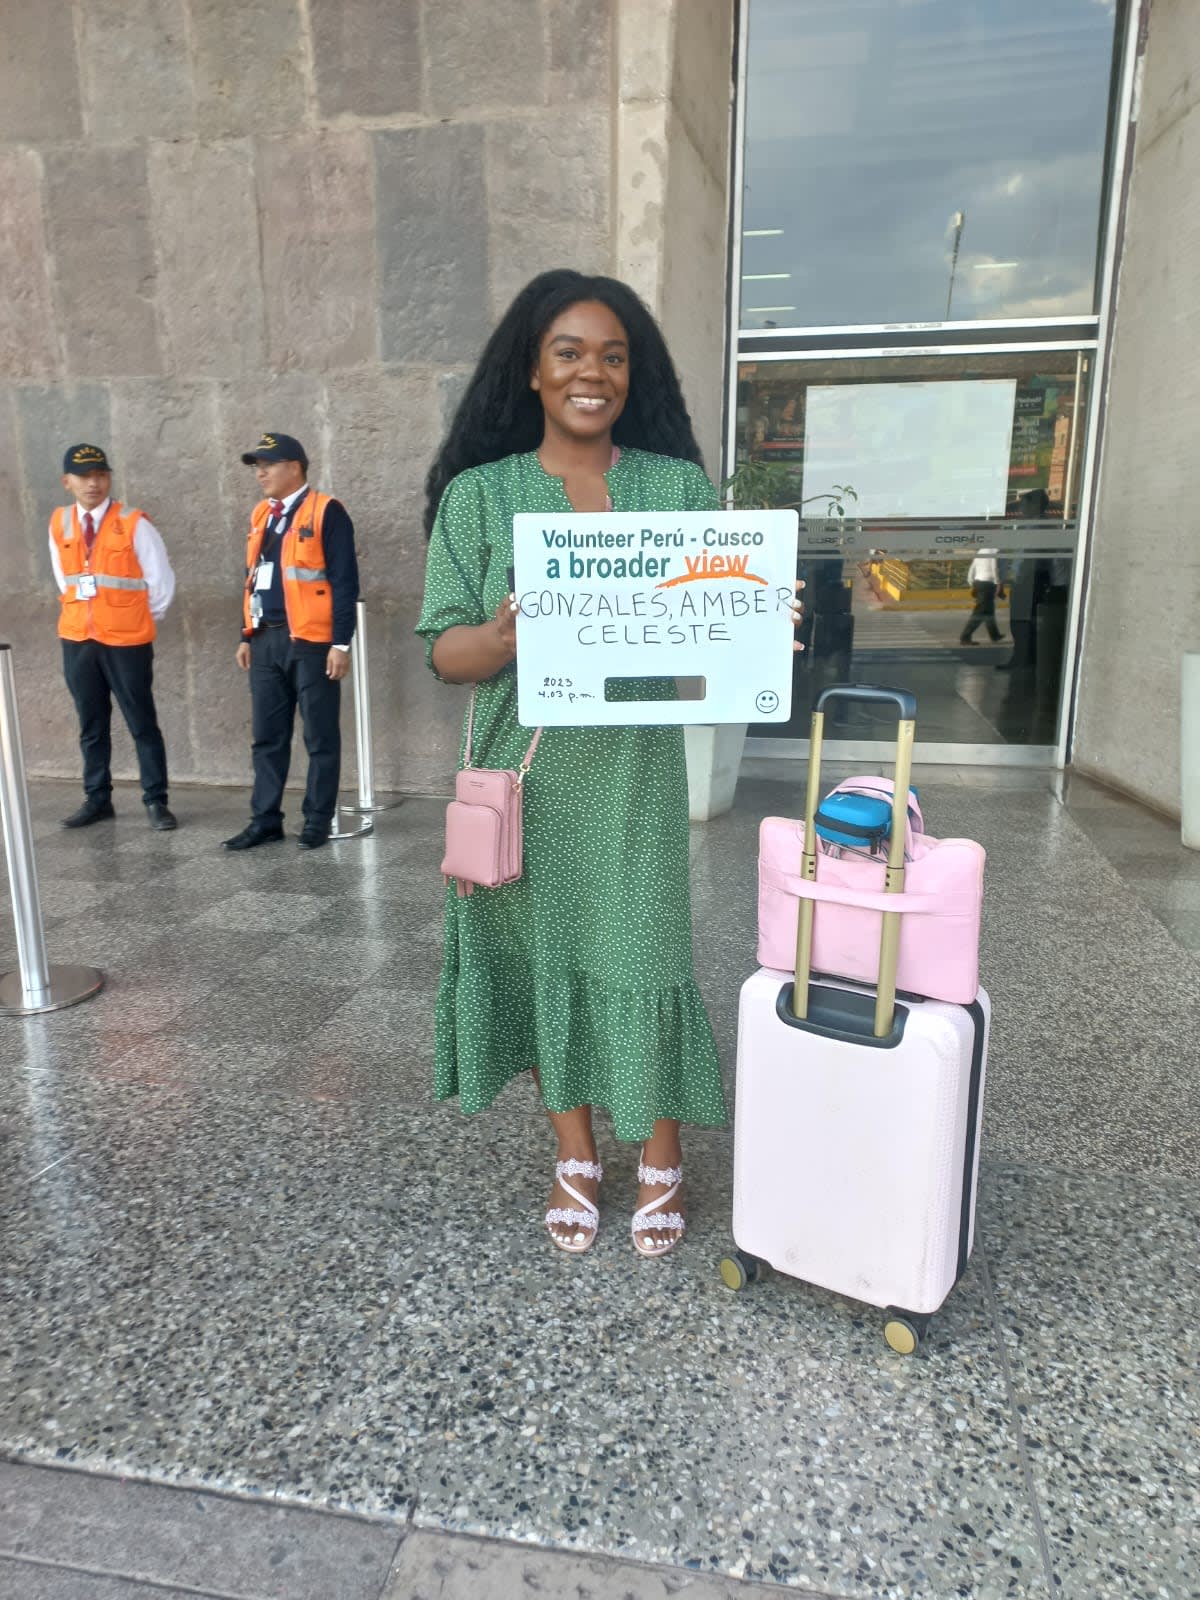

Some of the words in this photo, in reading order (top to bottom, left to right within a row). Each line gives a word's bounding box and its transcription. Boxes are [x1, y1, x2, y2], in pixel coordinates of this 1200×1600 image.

[542, 529, 635, 548] Volunteer
[641, 527, 684, 548] Perú
[703, 528, 764, 547] Cusco
[546, 558, 561, 579] a
[570, 551, 670, 578] broader
[684, 549, 749, 576] view
[578, 623, 731, 645] CELESTE
[543, 677, 573, 687] 2023
